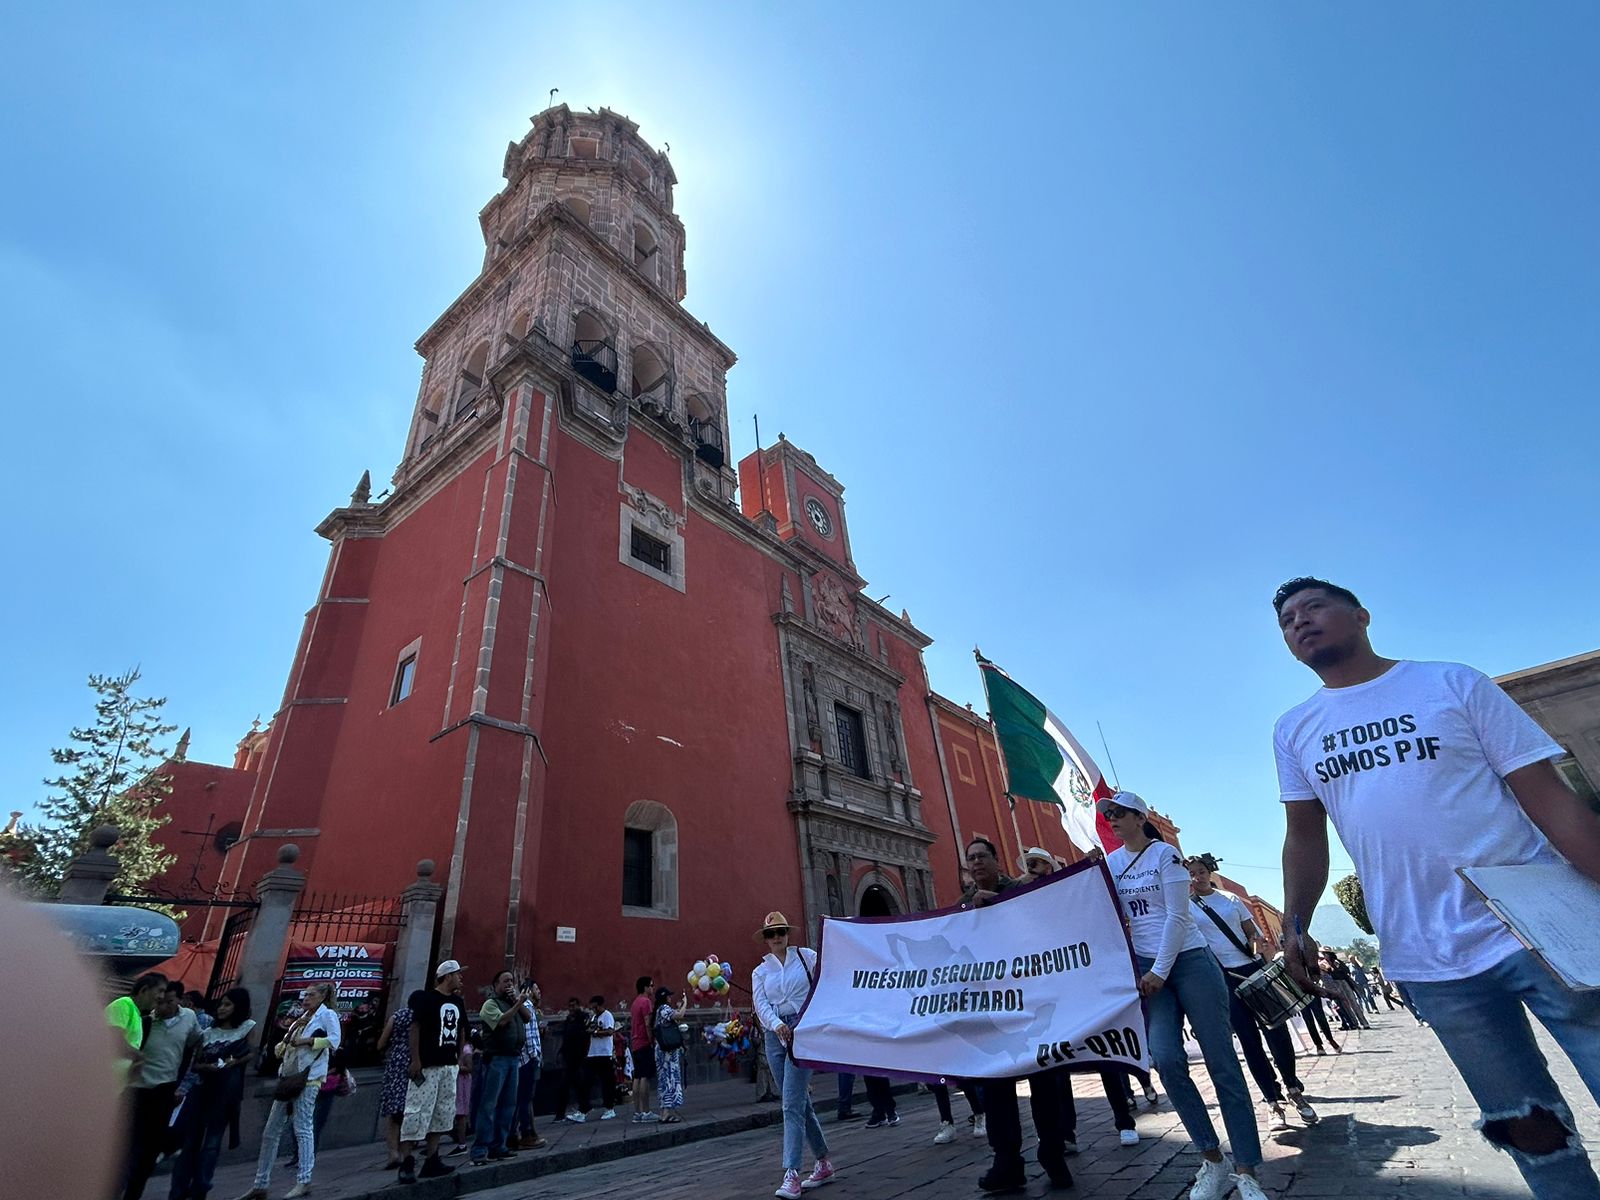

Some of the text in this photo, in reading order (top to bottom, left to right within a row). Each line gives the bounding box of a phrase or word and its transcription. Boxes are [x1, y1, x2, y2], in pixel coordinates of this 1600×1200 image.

[1321, 714, 1417, 753] #TODOS
[1314, 736, 1441, 784] SOMOS PJF
[315, 945, 369, 959] VENTA
[335, 959, 349, 967] de
[852, 941, 1092, 989] VIGÉSIMO SEGUNDO CIRCUITO
[302, 969, 373, 979] Guajolotes
[335, 981, 342, 989] y
